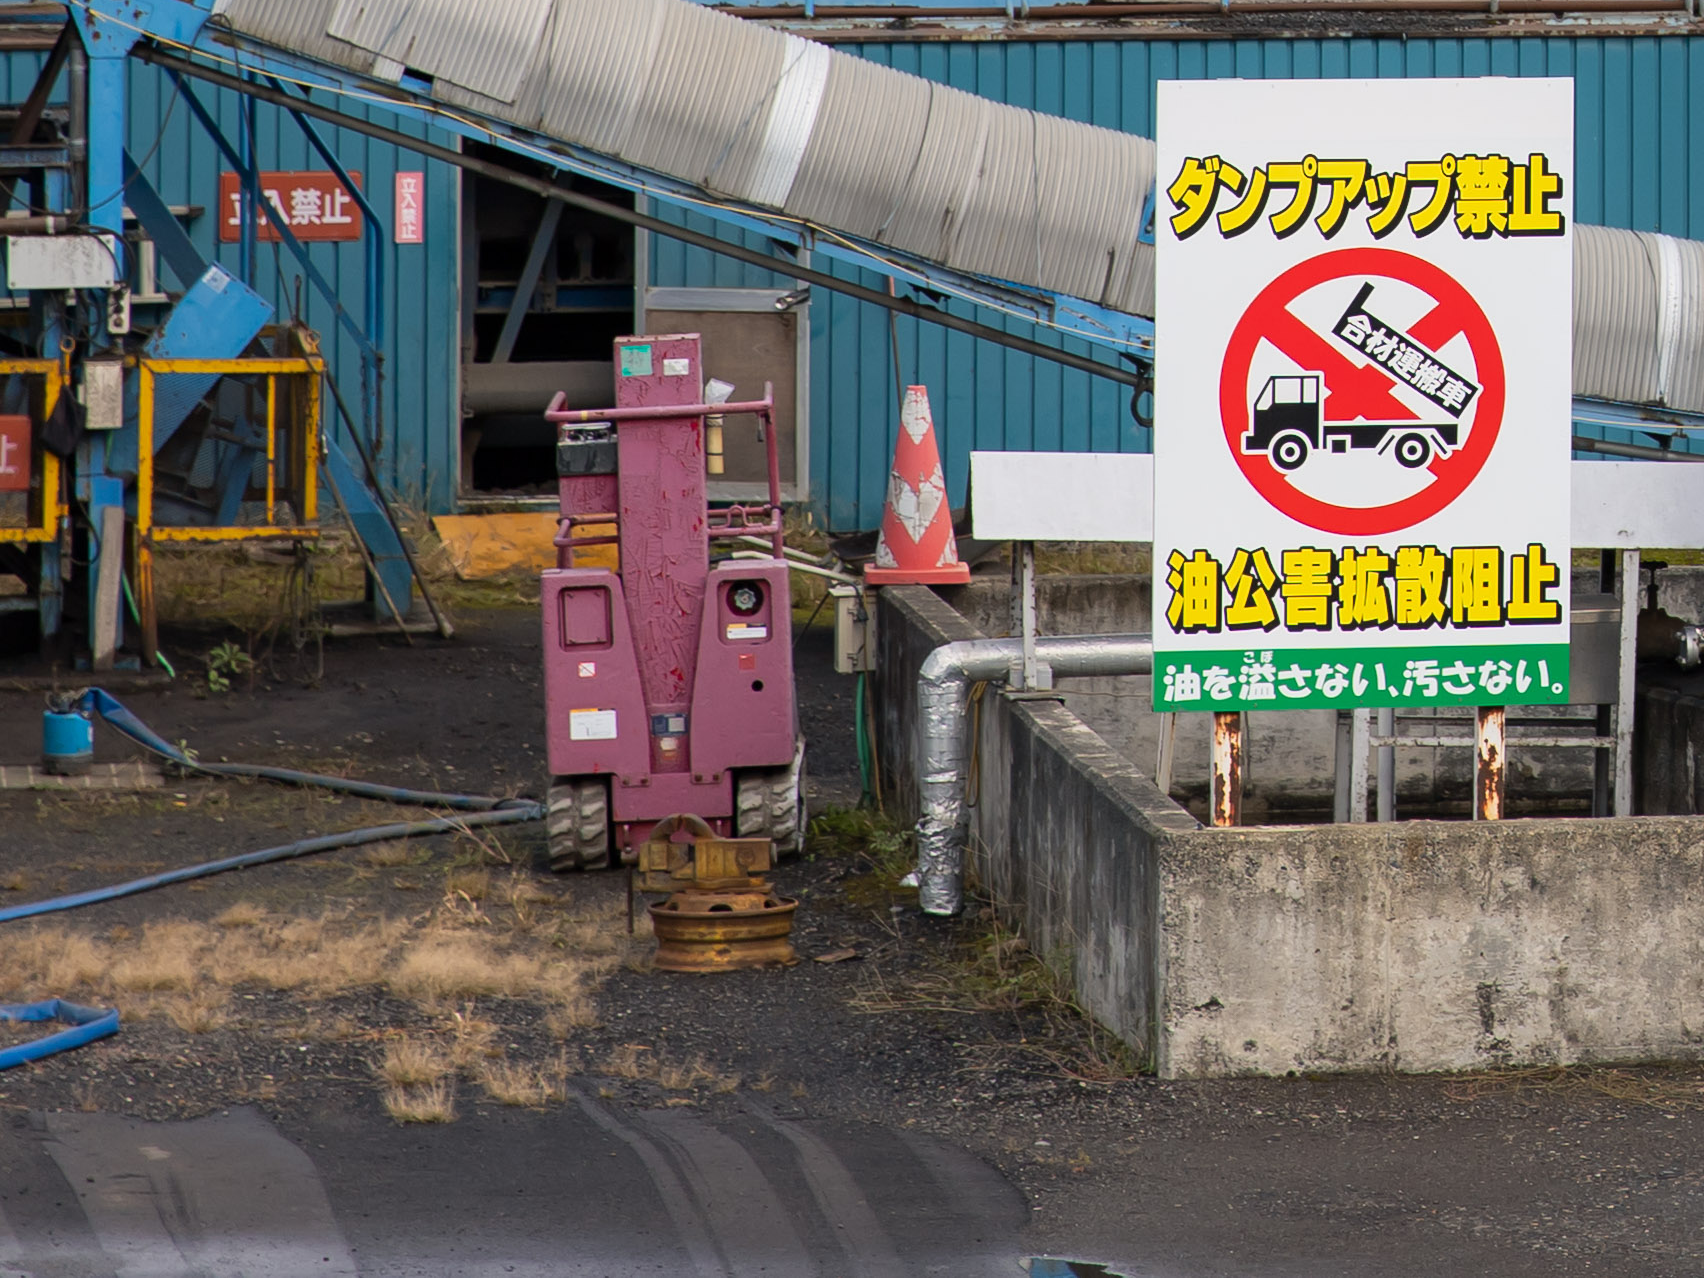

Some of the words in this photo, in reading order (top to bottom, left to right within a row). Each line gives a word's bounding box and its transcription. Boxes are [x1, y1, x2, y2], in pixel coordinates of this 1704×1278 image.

[400, 176, 418, 240] 立入禁止
[1166, 153, 1566, 240] ダンプアップ禁止
[1340, 314, 1473, 411] 合材運搬車
[1164, 542, 1561, 634] 油公害拡散阻止
[1162, 658, 1564, 703] 油を溢さない、汚さない。
